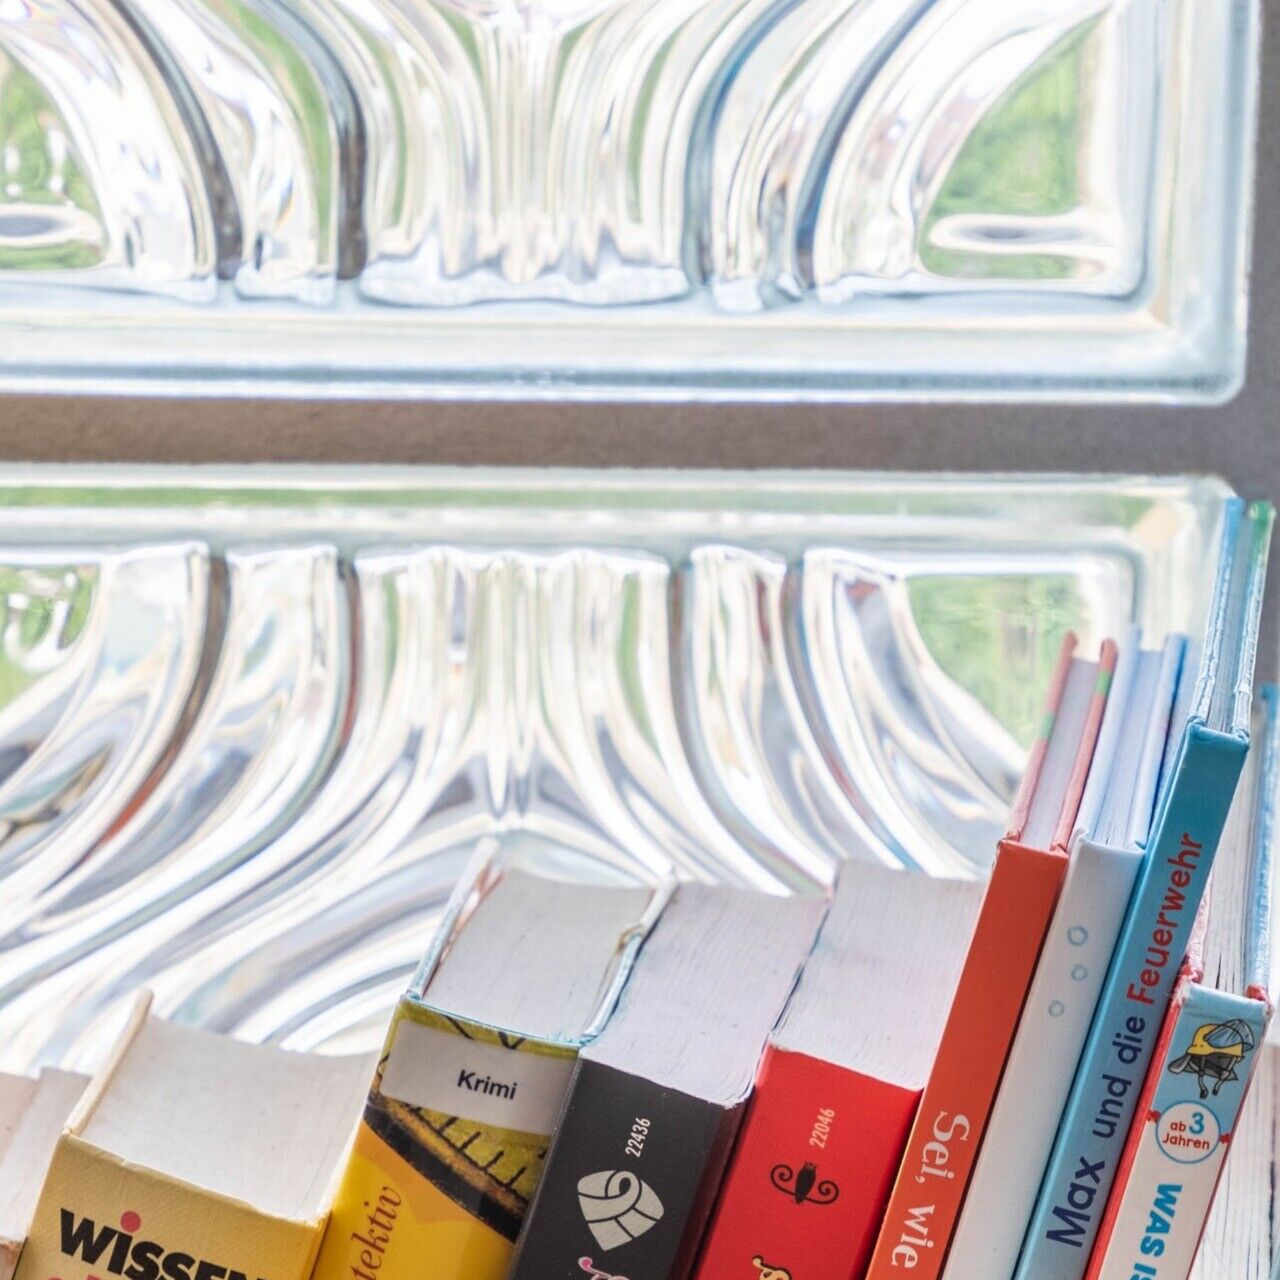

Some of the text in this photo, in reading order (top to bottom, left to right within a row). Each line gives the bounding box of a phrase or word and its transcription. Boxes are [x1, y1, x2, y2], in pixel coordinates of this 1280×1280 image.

[1046, 832, 1204, 1247] Max und die Feuerwehr
[457, 1069, 519, 1100] Krimi
[624, 1117, 651, 1158] 22436
[809, 1107, 836, 1150] 22046
[891, 1205, 935, 1269] wie
[1140, 1183, 1183, 1257] WAS
